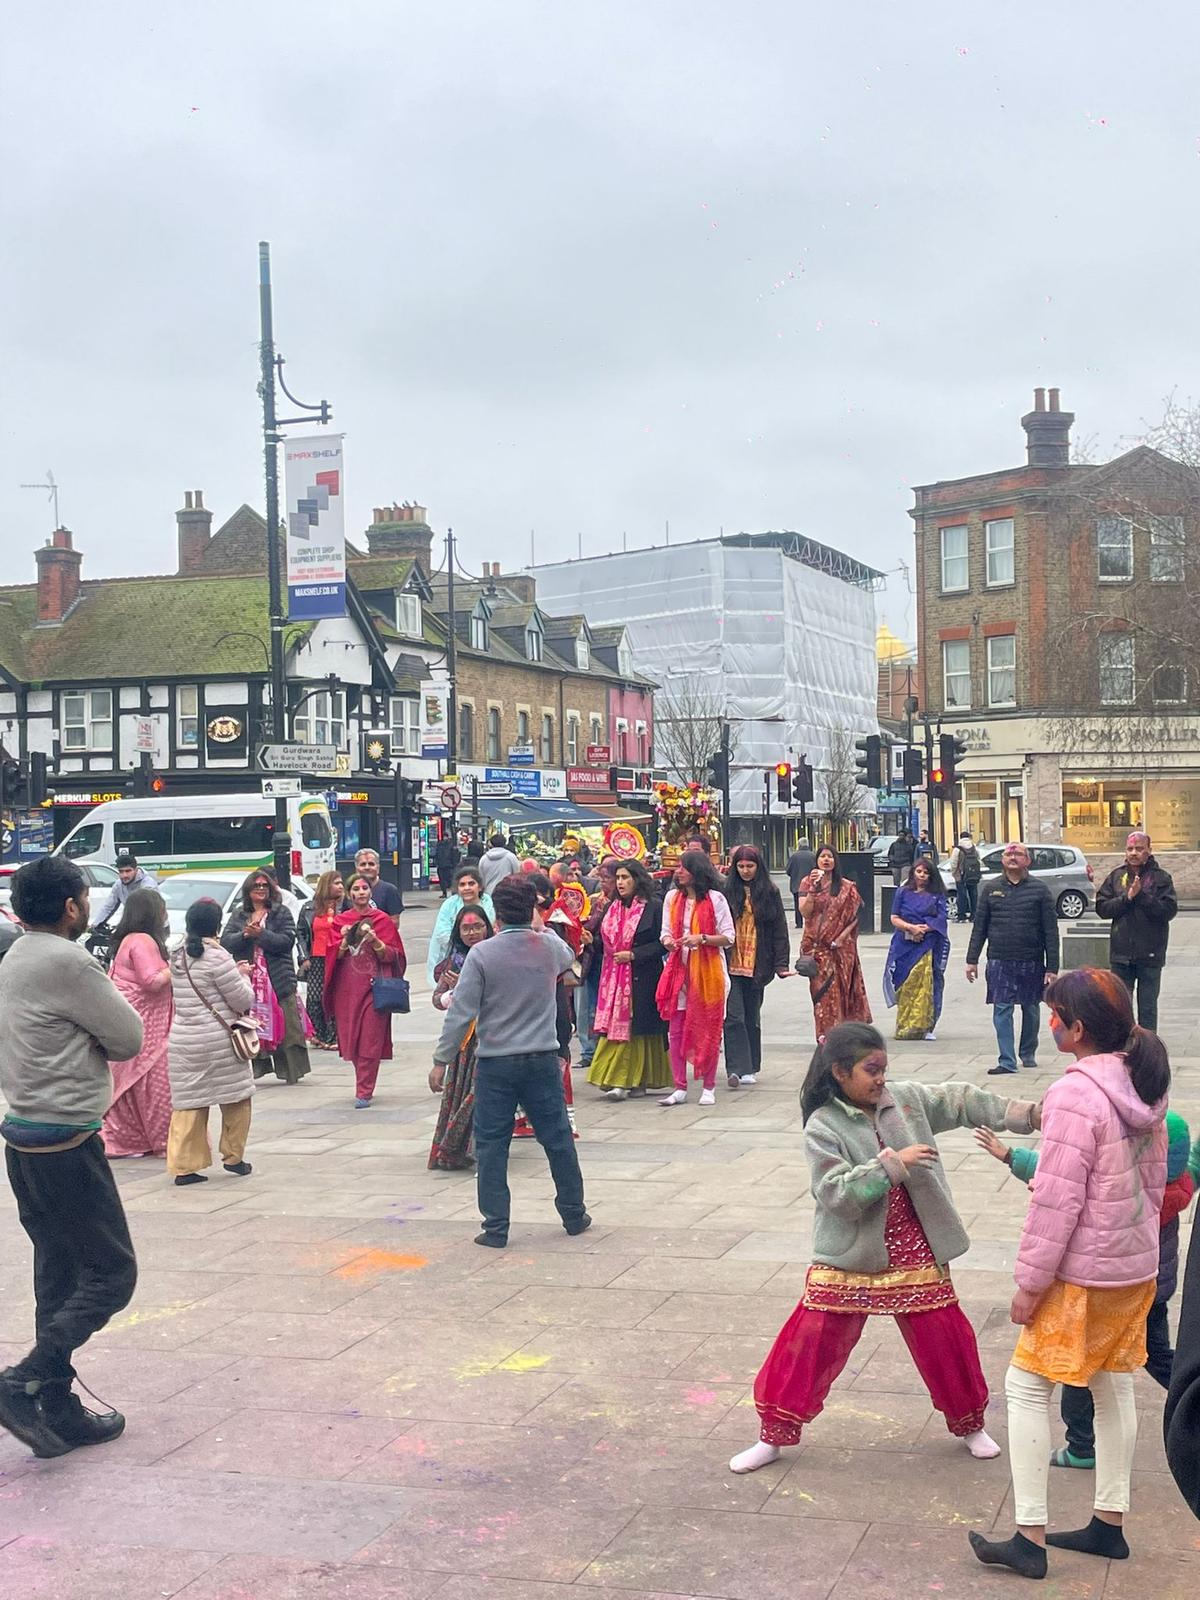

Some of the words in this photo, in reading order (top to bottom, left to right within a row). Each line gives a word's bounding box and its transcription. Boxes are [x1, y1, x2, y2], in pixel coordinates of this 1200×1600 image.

[578, 772, 591, 783] FOOD
[54, 794, 91, 802] MERKUR
[92, 794, 122, 802] SLOTS
[351, 792, 369, 801] SLOTS
